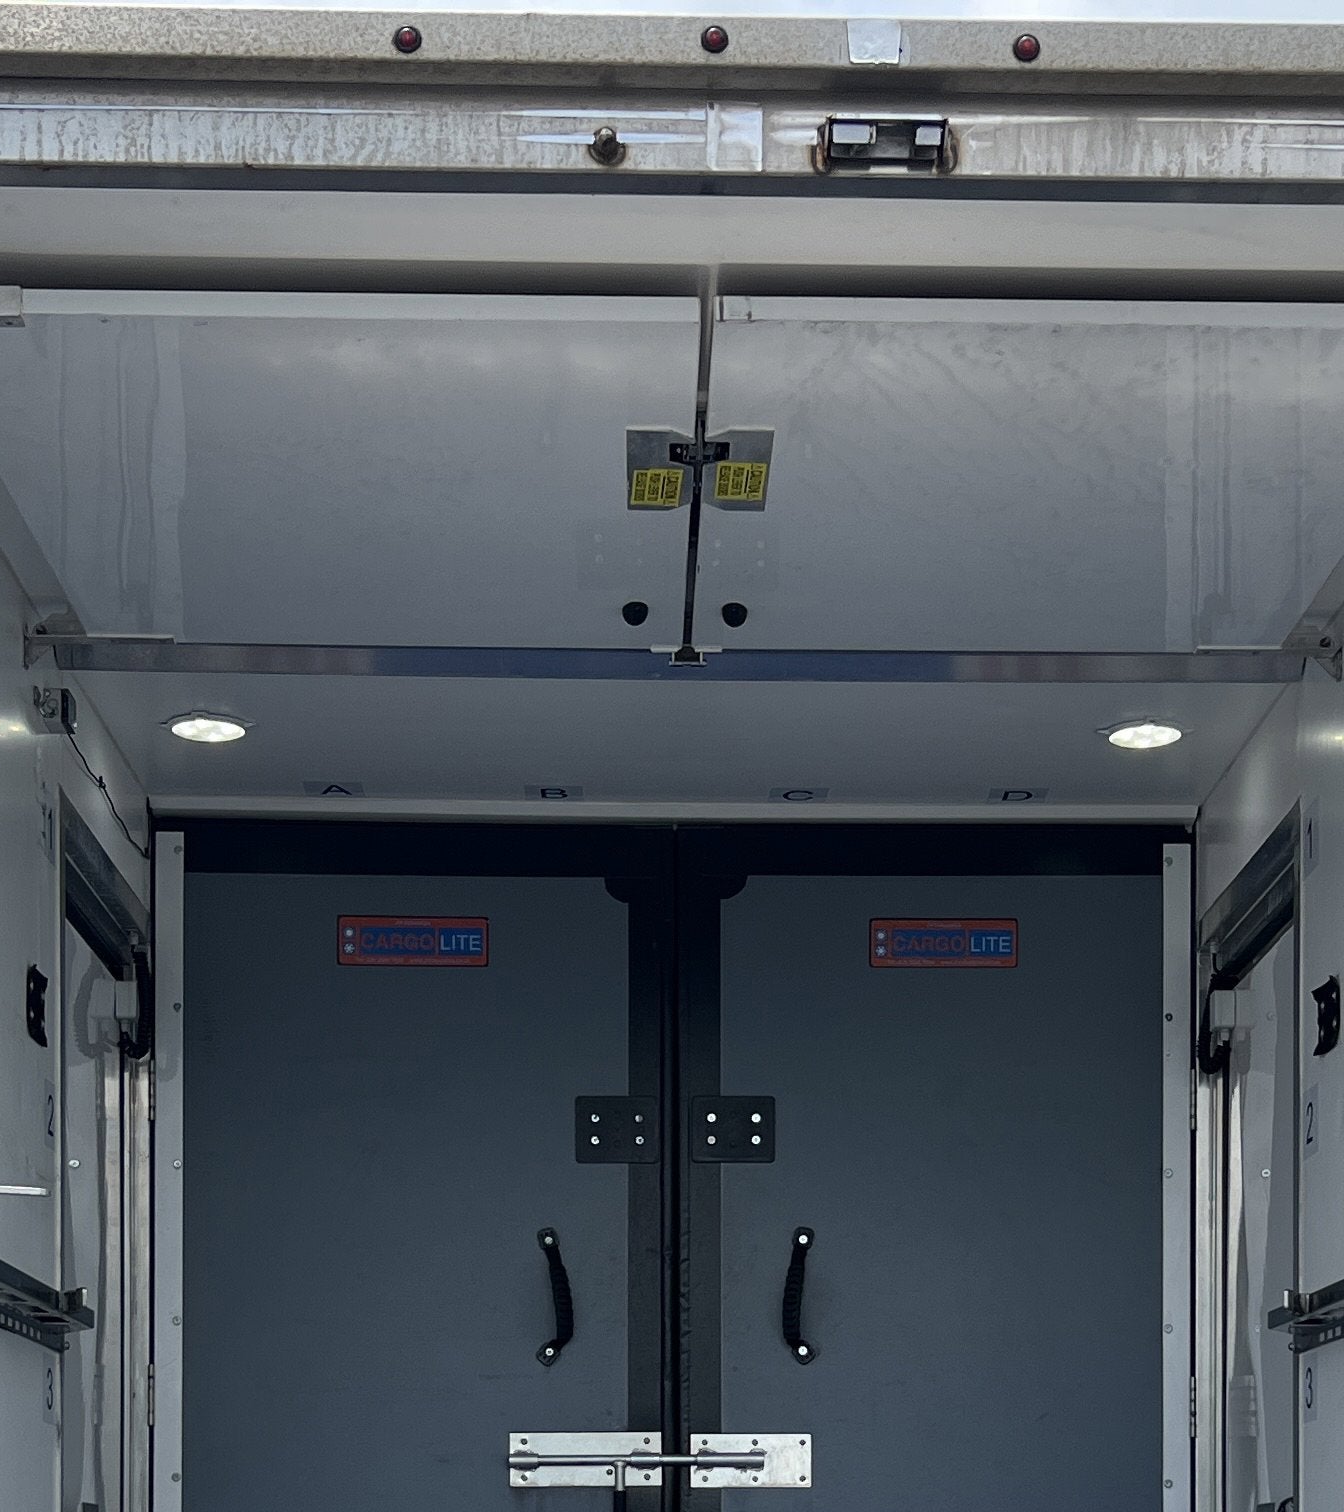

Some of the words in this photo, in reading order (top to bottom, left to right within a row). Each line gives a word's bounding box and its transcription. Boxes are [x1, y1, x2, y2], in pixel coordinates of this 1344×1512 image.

[321, 784, 353, 796] A
[540, 787, 568, 799] B
[782, 790, 814, 801] C
[1001, 790, 1033, 801] D
[1306, 817, 1313, 859] 1
[440, 934, 482, 951] LITE
[970, 936, 1012, 952] LITE
[47, 1094, 54, 1137] 2
[1306, 1101, 1314, 1145] 2
[46, 1367, 54, 1410] 3
[1305, 1366, 1313, 1409] 3
